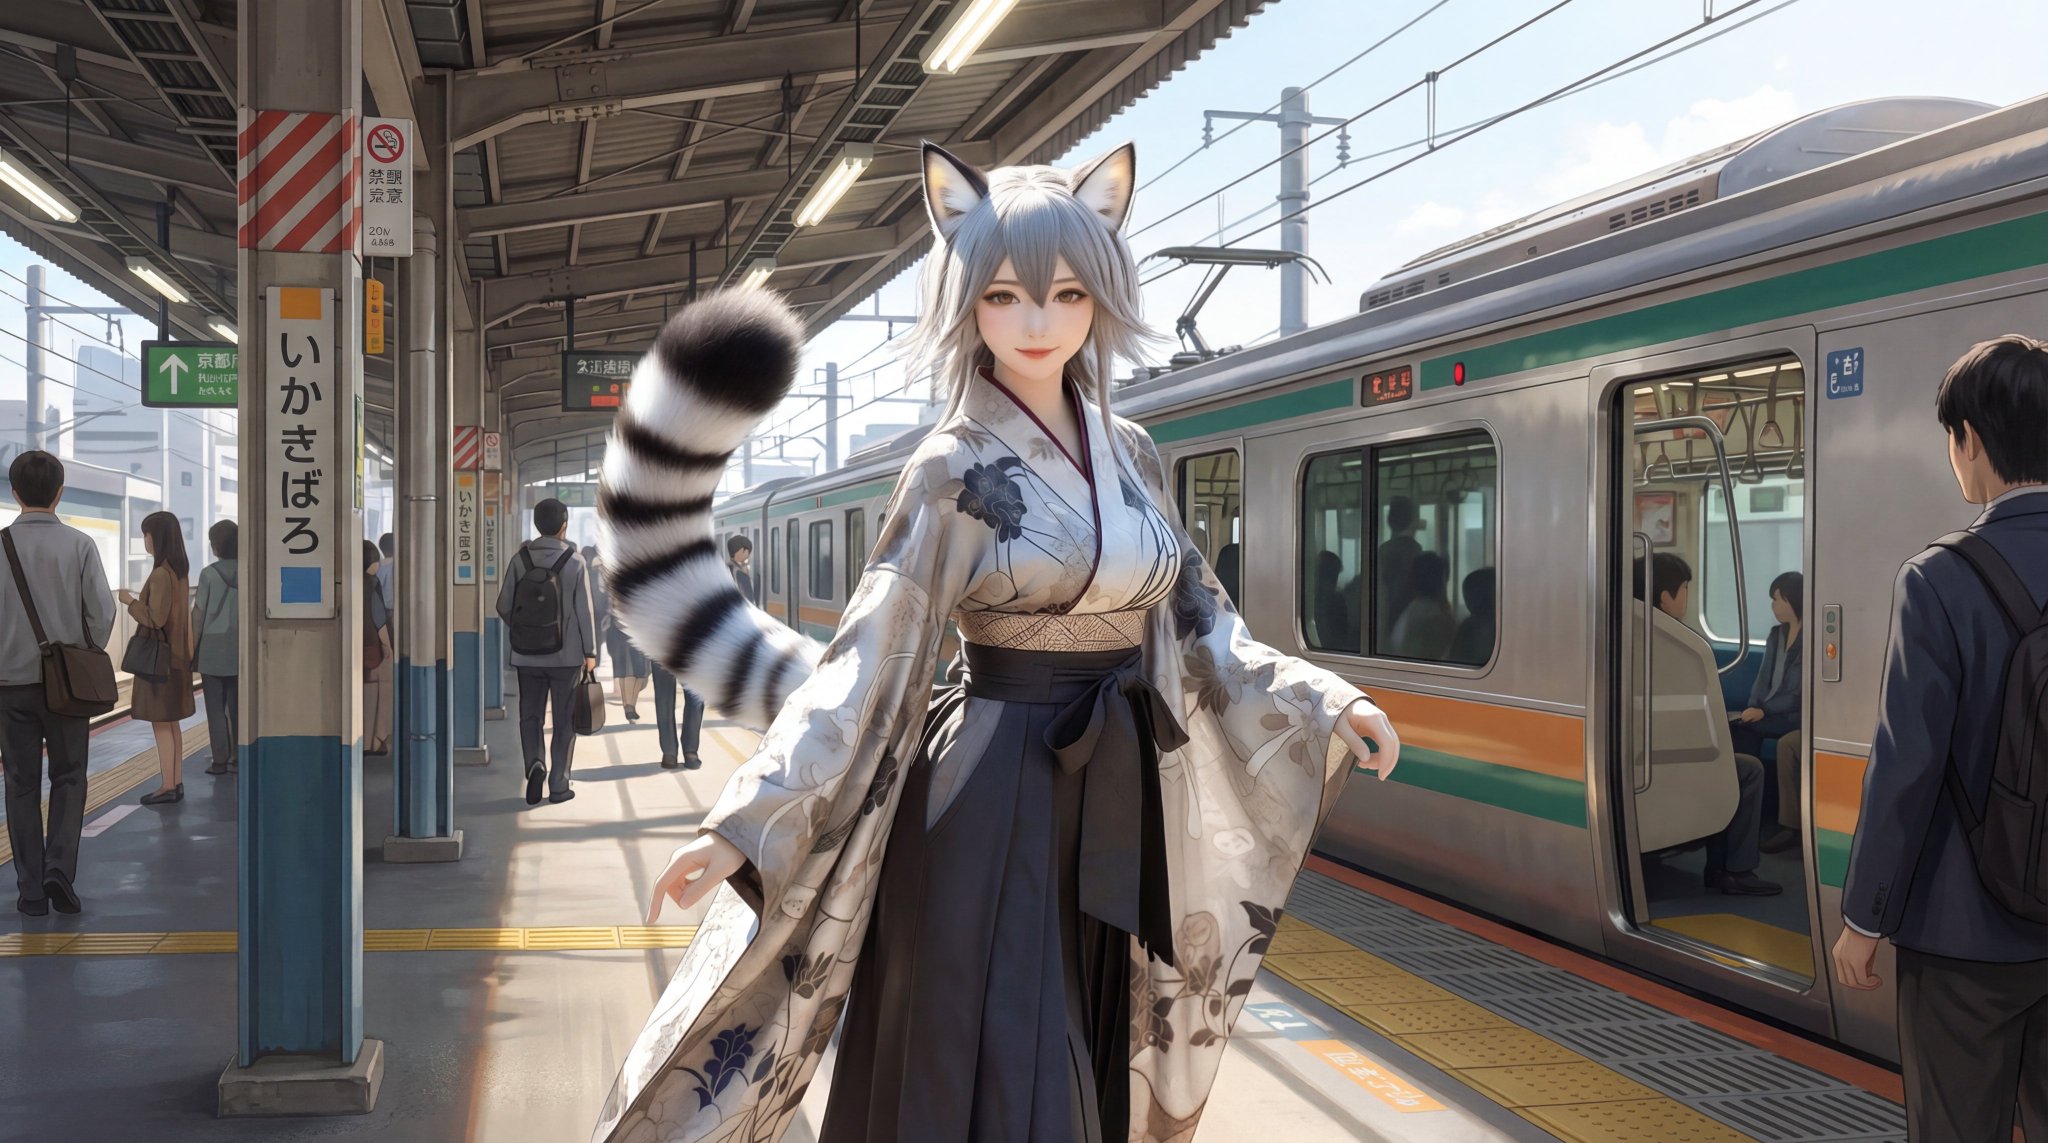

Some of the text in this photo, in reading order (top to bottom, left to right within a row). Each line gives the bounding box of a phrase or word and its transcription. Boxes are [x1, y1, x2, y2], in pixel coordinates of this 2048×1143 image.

[280, 332, 322, 555] いかきばろ
